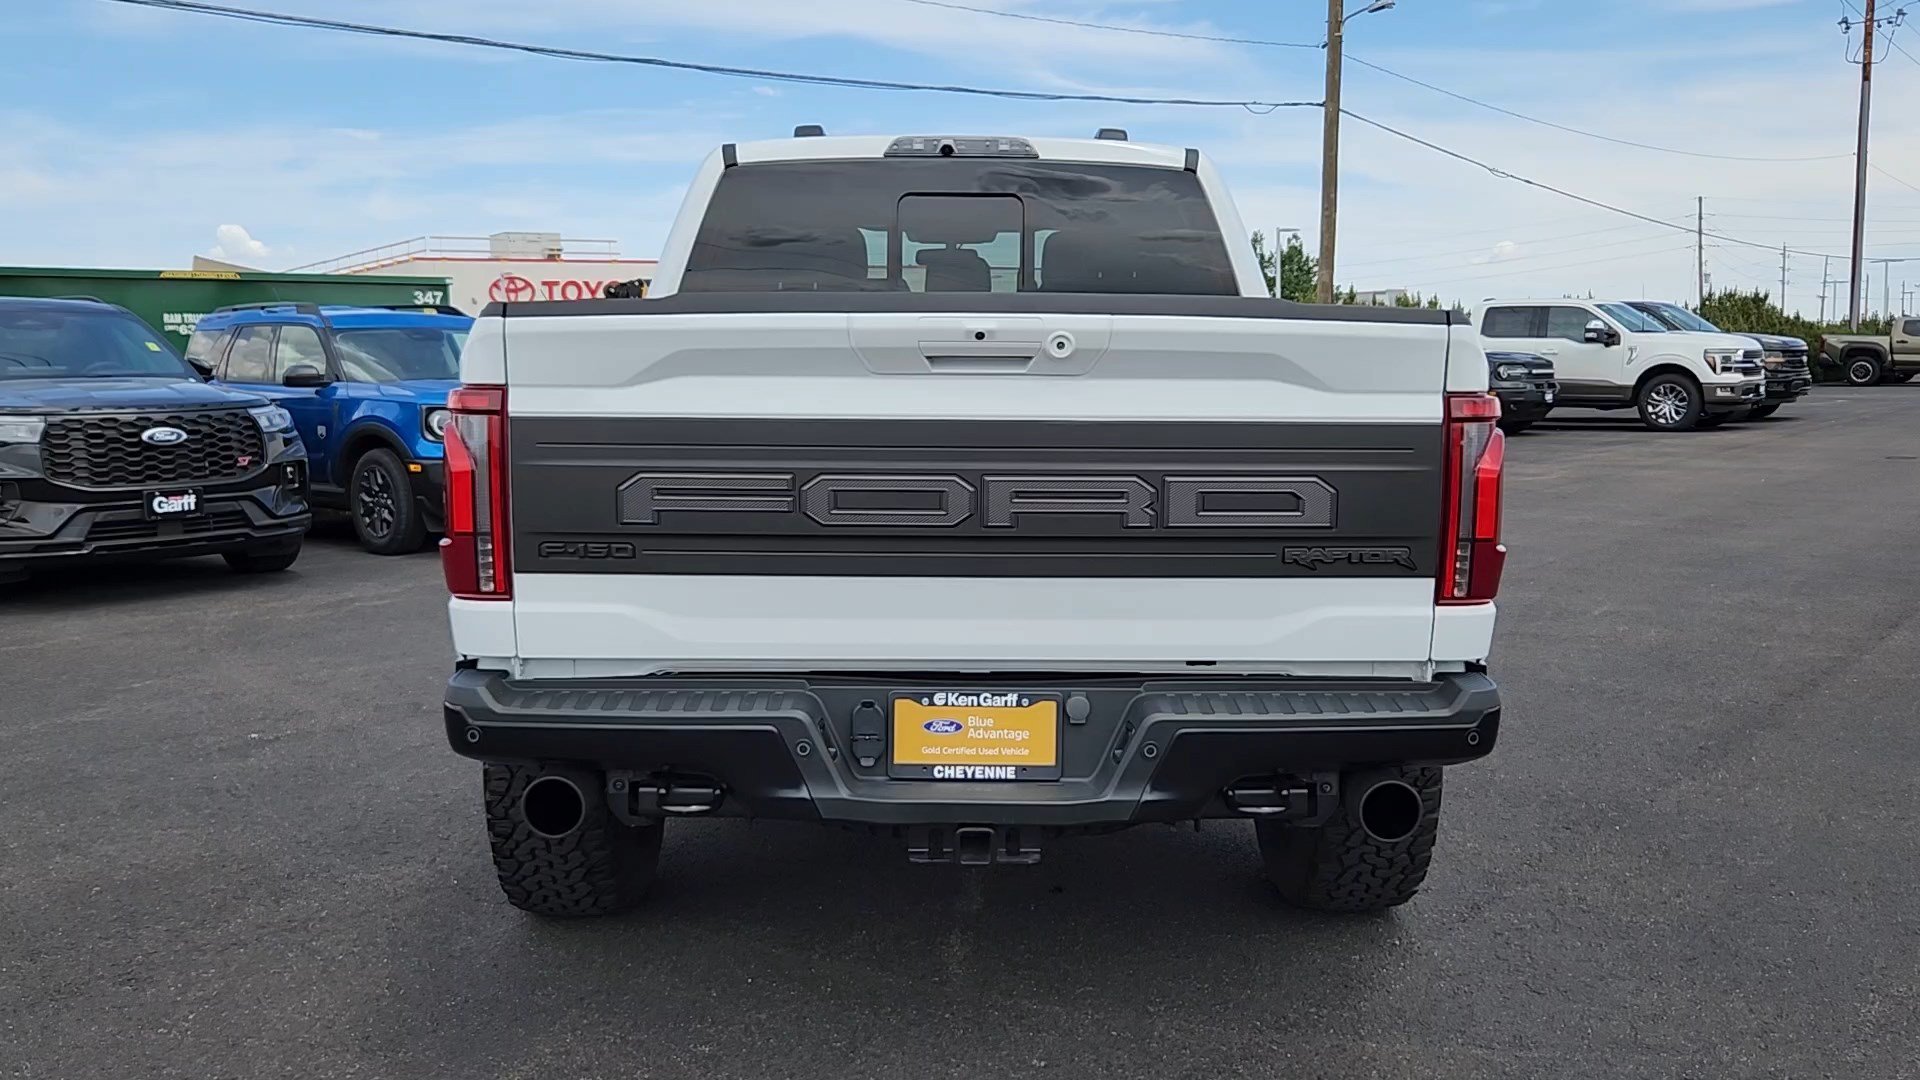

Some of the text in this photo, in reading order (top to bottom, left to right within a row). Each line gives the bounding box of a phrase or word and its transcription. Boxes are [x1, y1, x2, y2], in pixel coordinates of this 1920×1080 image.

[413, 289, 443, 305] 347
[152, 494, 196, 514] Garff
[616, 472, 1338, 529] FORD
[1283, 546, 1416, 570] RAPTOR
[947, 693, 1018, 707] Ken Garff
[967, 716, 994, 727] Blue
[967, 728, 1030, 741] Advantage
[921, 746, 1030, 756] Gold Certified Used Vehicle
[933, 766, 1016, 779] CHEYENNE
